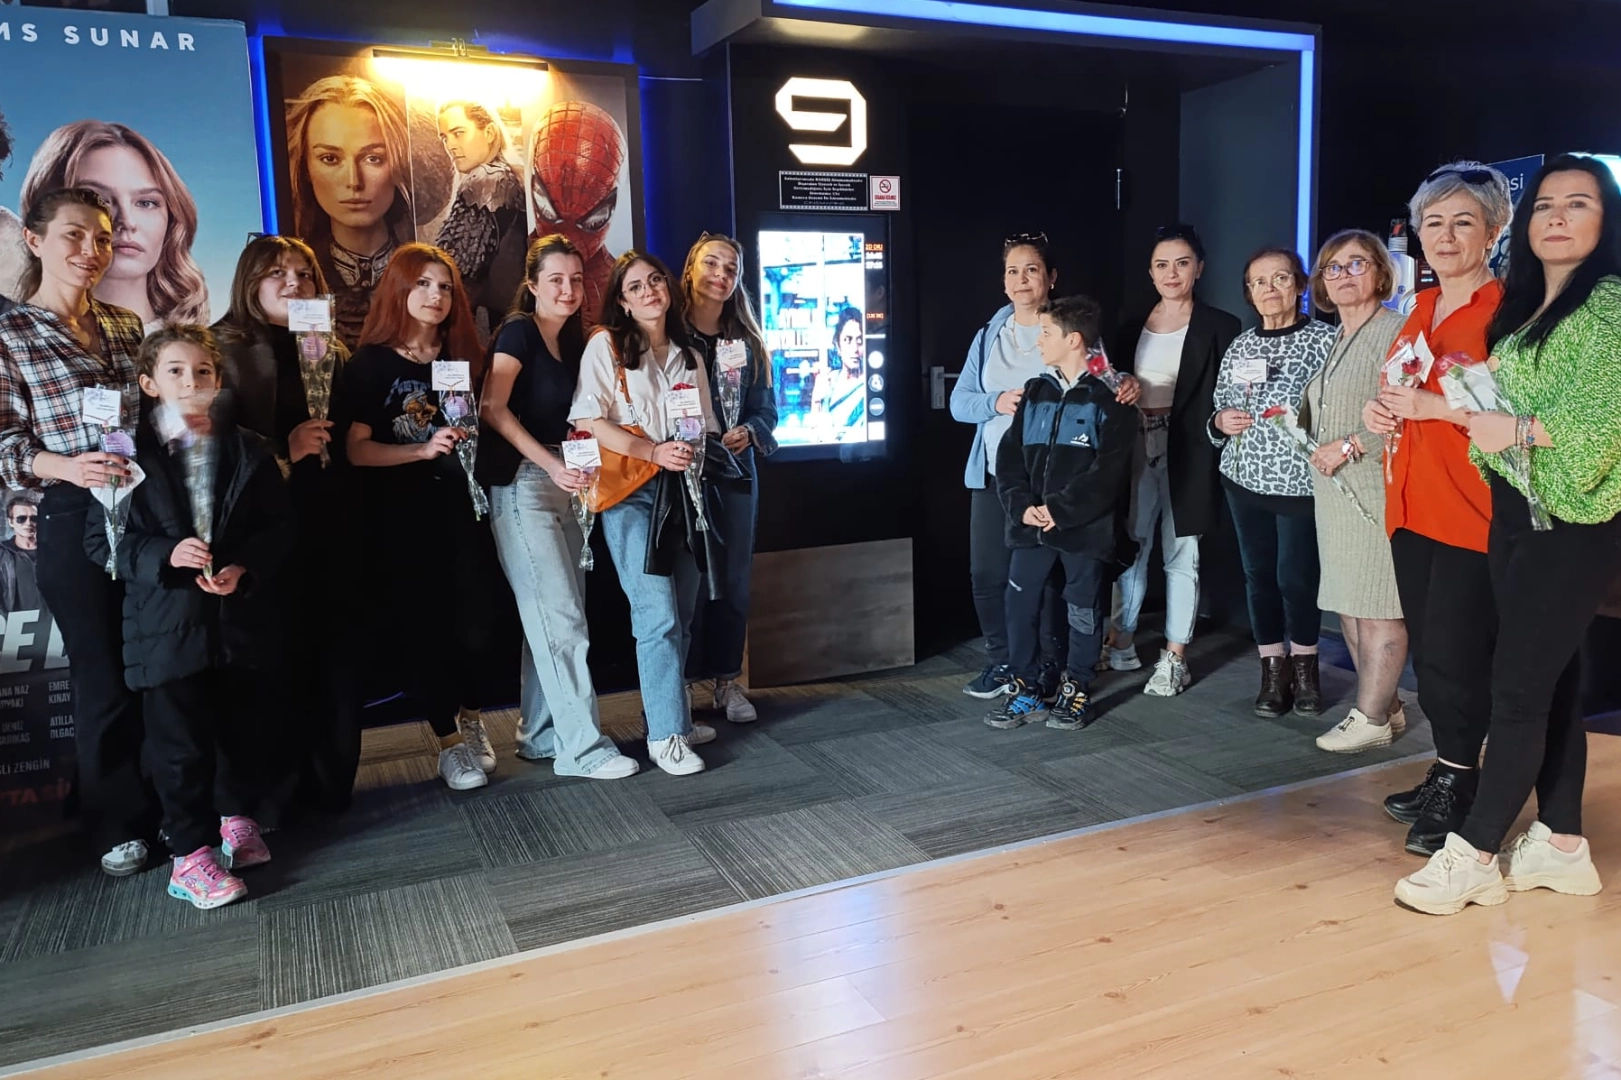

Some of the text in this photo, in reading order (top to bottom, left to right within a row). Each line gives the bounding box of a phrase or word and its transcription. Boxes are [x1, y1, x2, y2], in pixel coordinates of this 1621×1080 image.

[64, 26, 195, 51] SUNAR
[775, 77, 867, 166] 9
[14, 684, 30, 696] NAZ
[48, 680, 70, 692] EMRE
[48, 692, 71, 704] KINAY
[14, 757, 50, 774] ZENGİN
